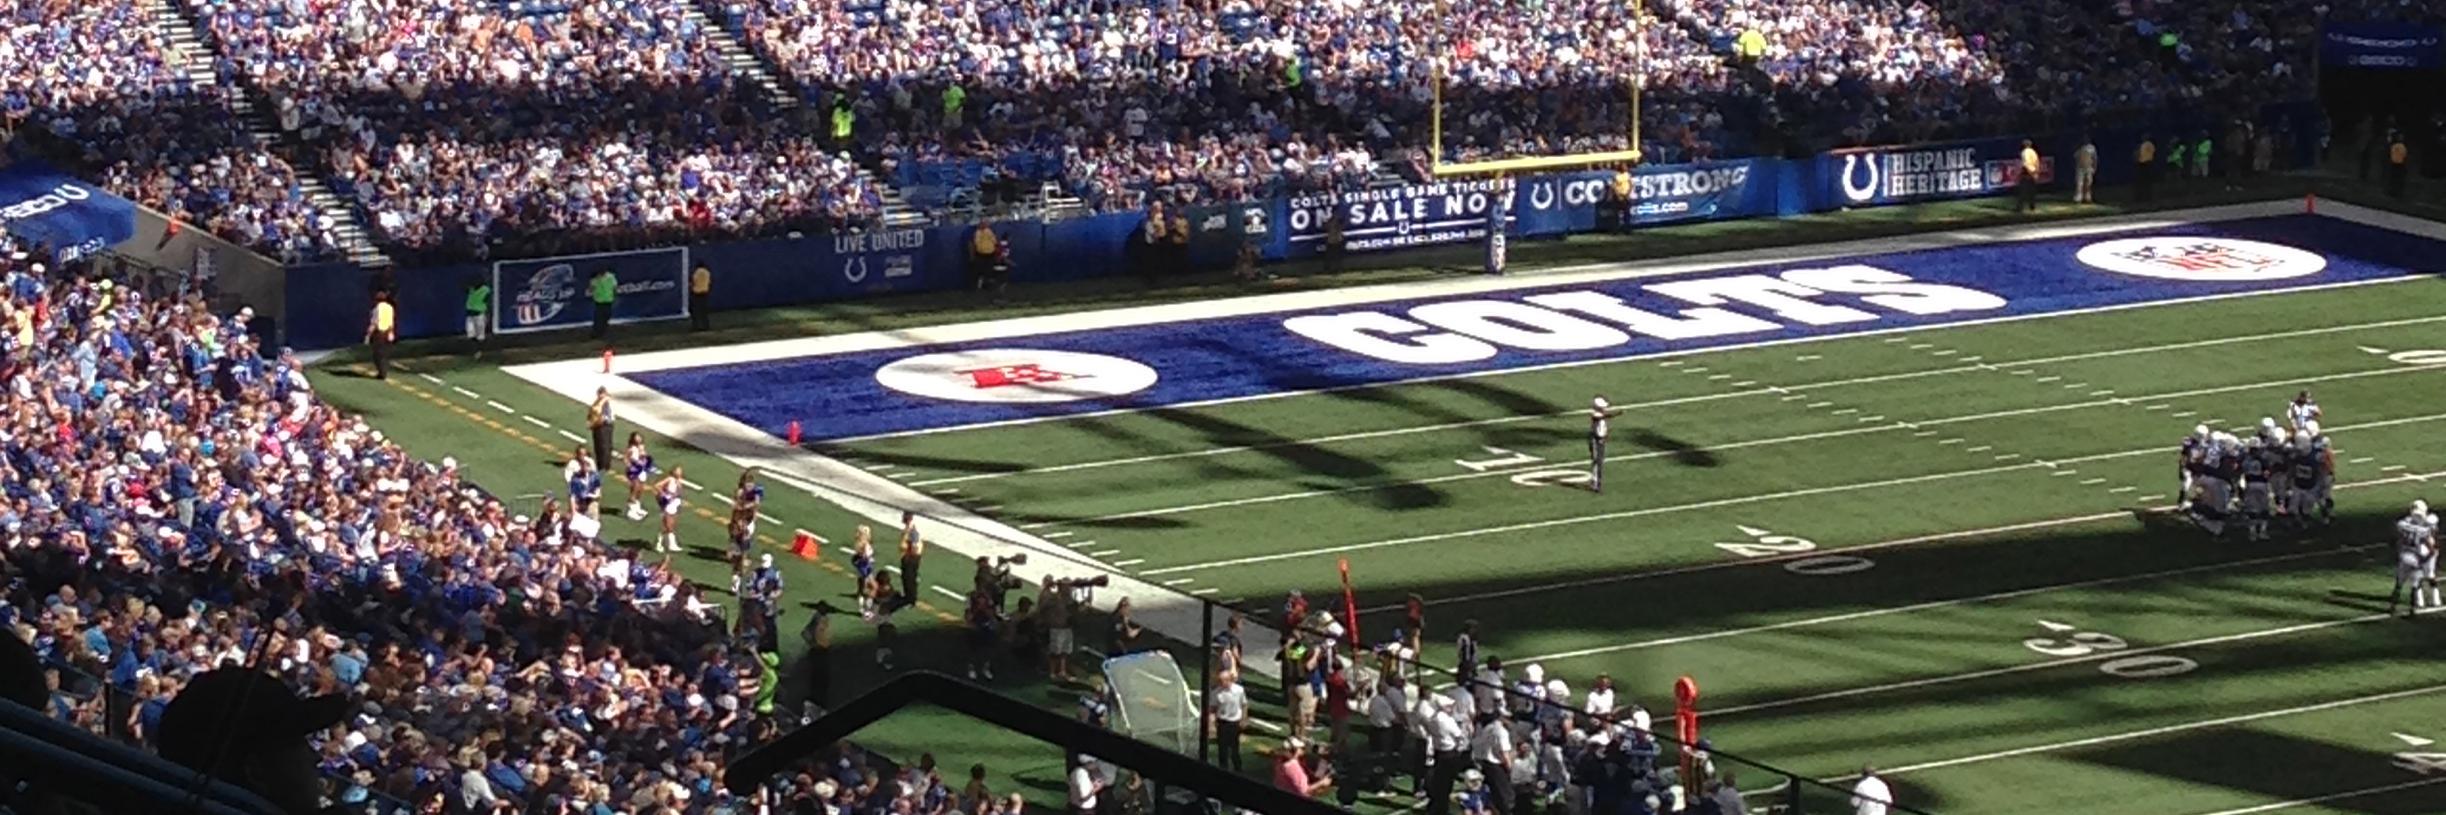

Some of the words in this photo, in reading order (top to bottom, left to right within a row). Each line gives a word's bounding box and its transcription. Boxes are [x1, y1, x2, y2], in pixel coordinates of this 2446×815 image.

[1891, 148, 1976, 173] HISPANIC
[1344, 187, 1400, 203] SINGLE
[1406, 182, 1448, 199] GAME
[1564, 165, 1750, 205] COTSTRONG
[1891, 167, 1982, 196] HERITAGE
[1290, 207, 1333, 231] ON
[1349, 198, 1429, 225] SALE
[835, 232, 868, 254] LIVE
[871, 229, 925, 252] UNITED
[1282, 264, 2008, 364] COLTS
[1713, 535, 1877, 575] 20
[2023, 631, 2199, 677] 30
